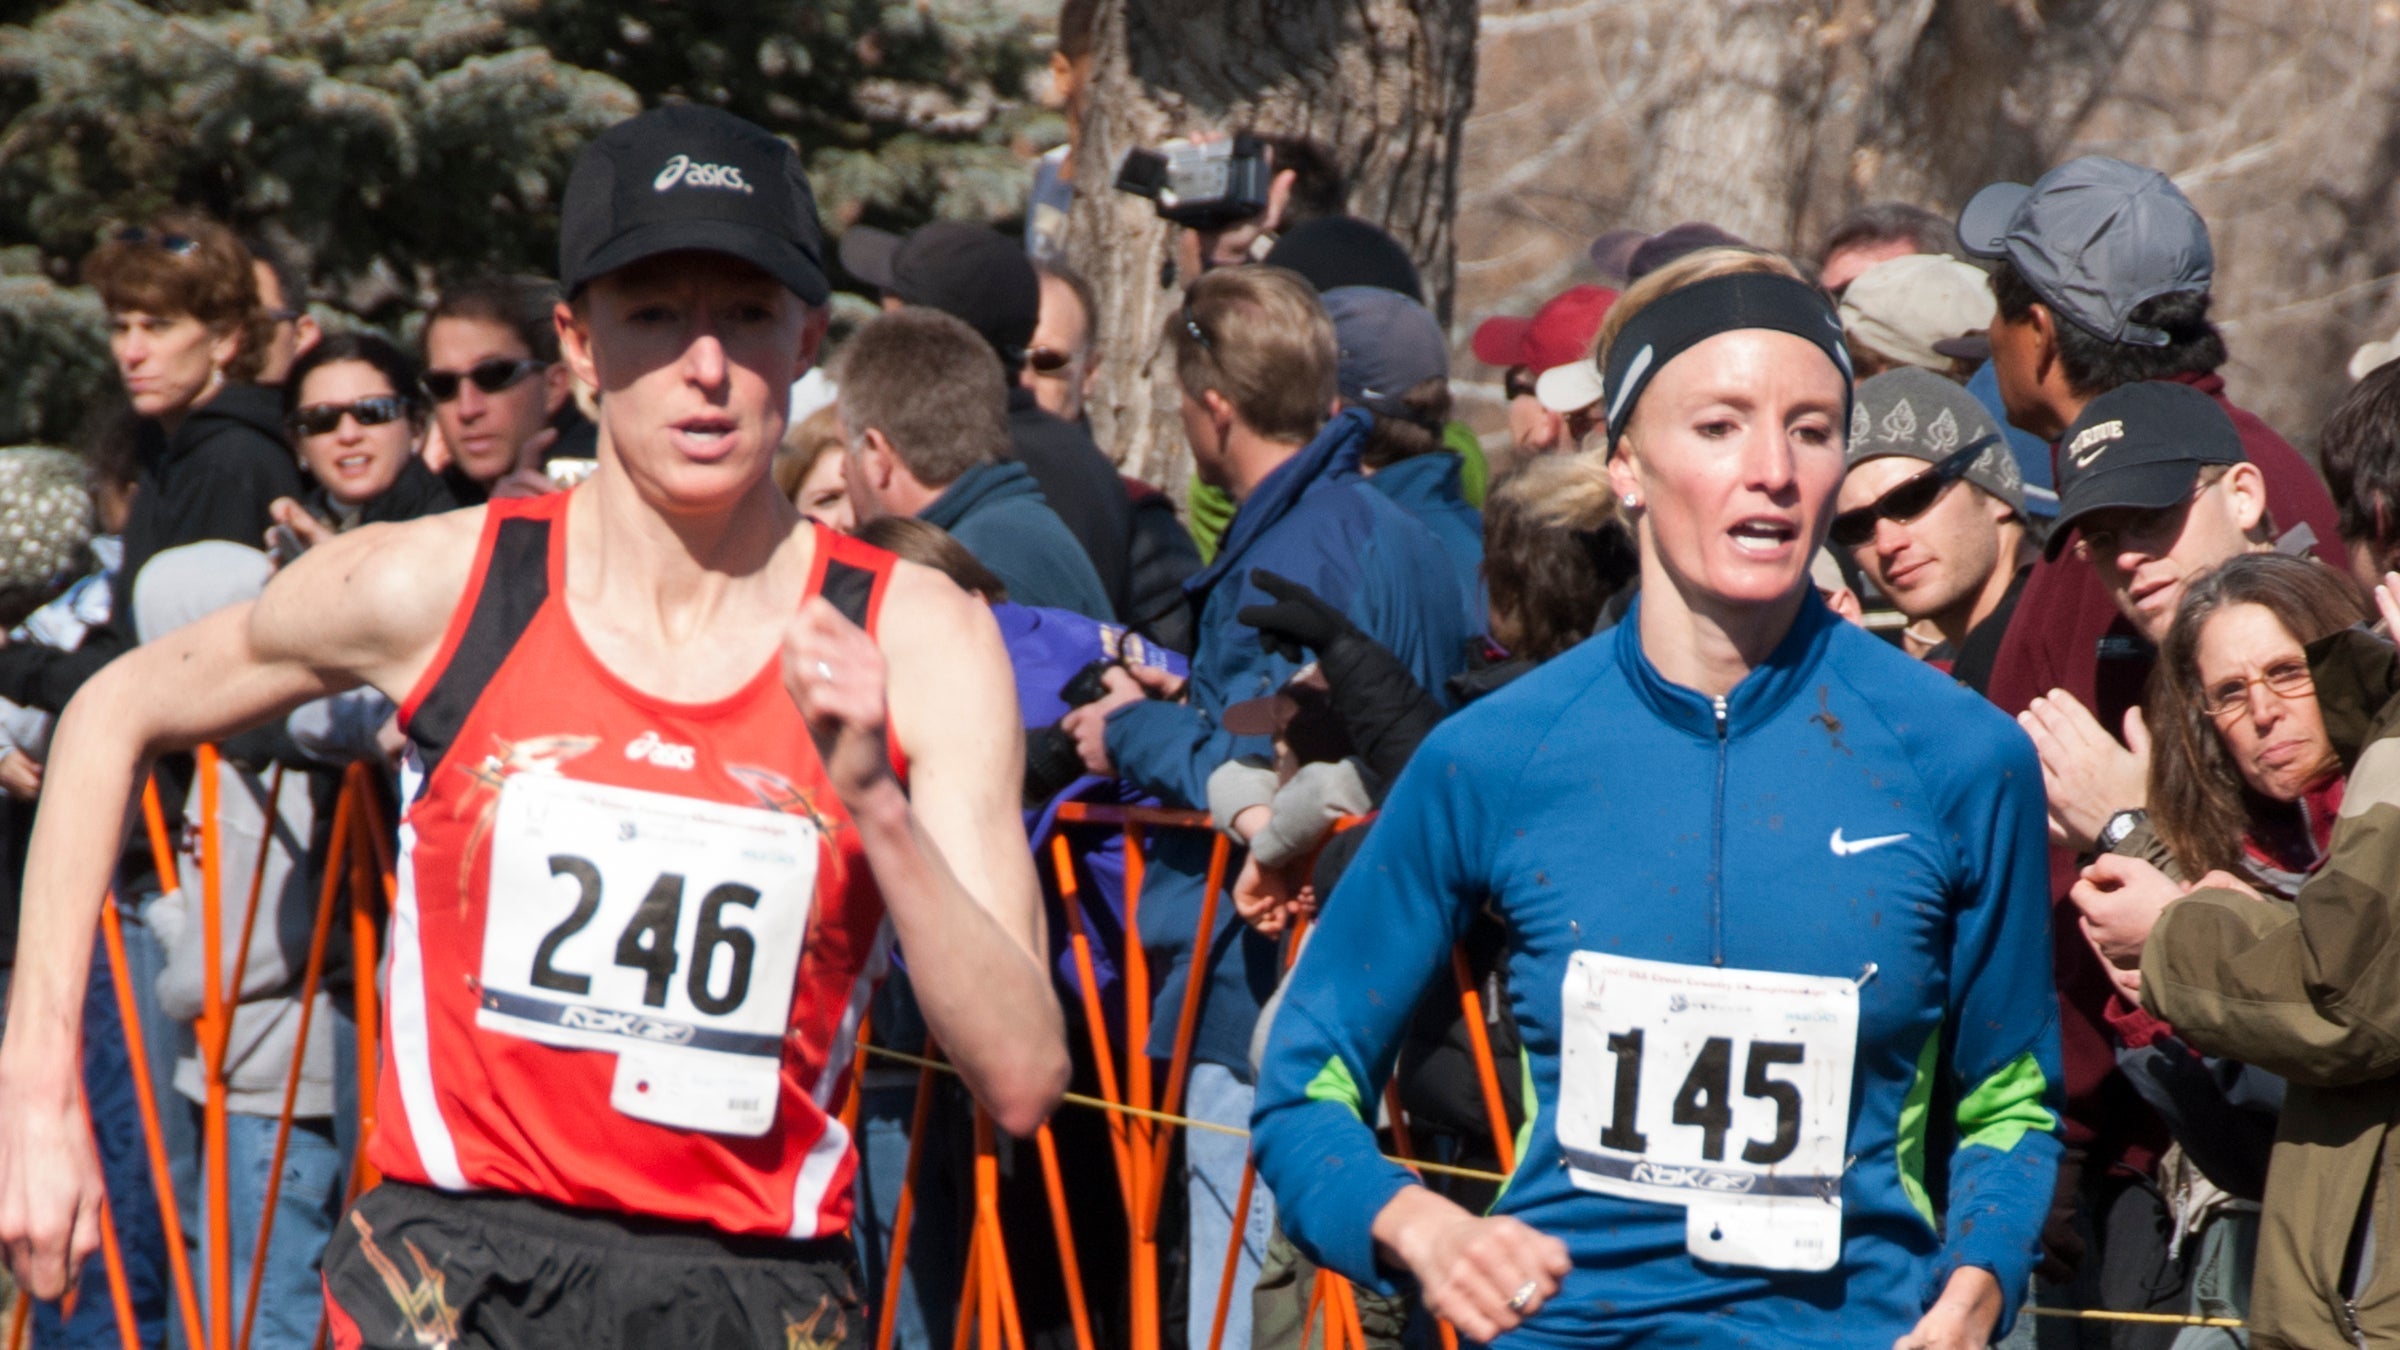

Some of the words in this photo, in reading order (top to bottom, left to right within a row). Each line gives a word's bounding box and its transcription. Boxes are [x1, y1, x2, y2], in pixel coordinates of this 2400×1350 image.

[684, 162, 744, 190] asics
[529, 854, 762, 1016] 246
[1600, 1027, 1806, 1165] 145
